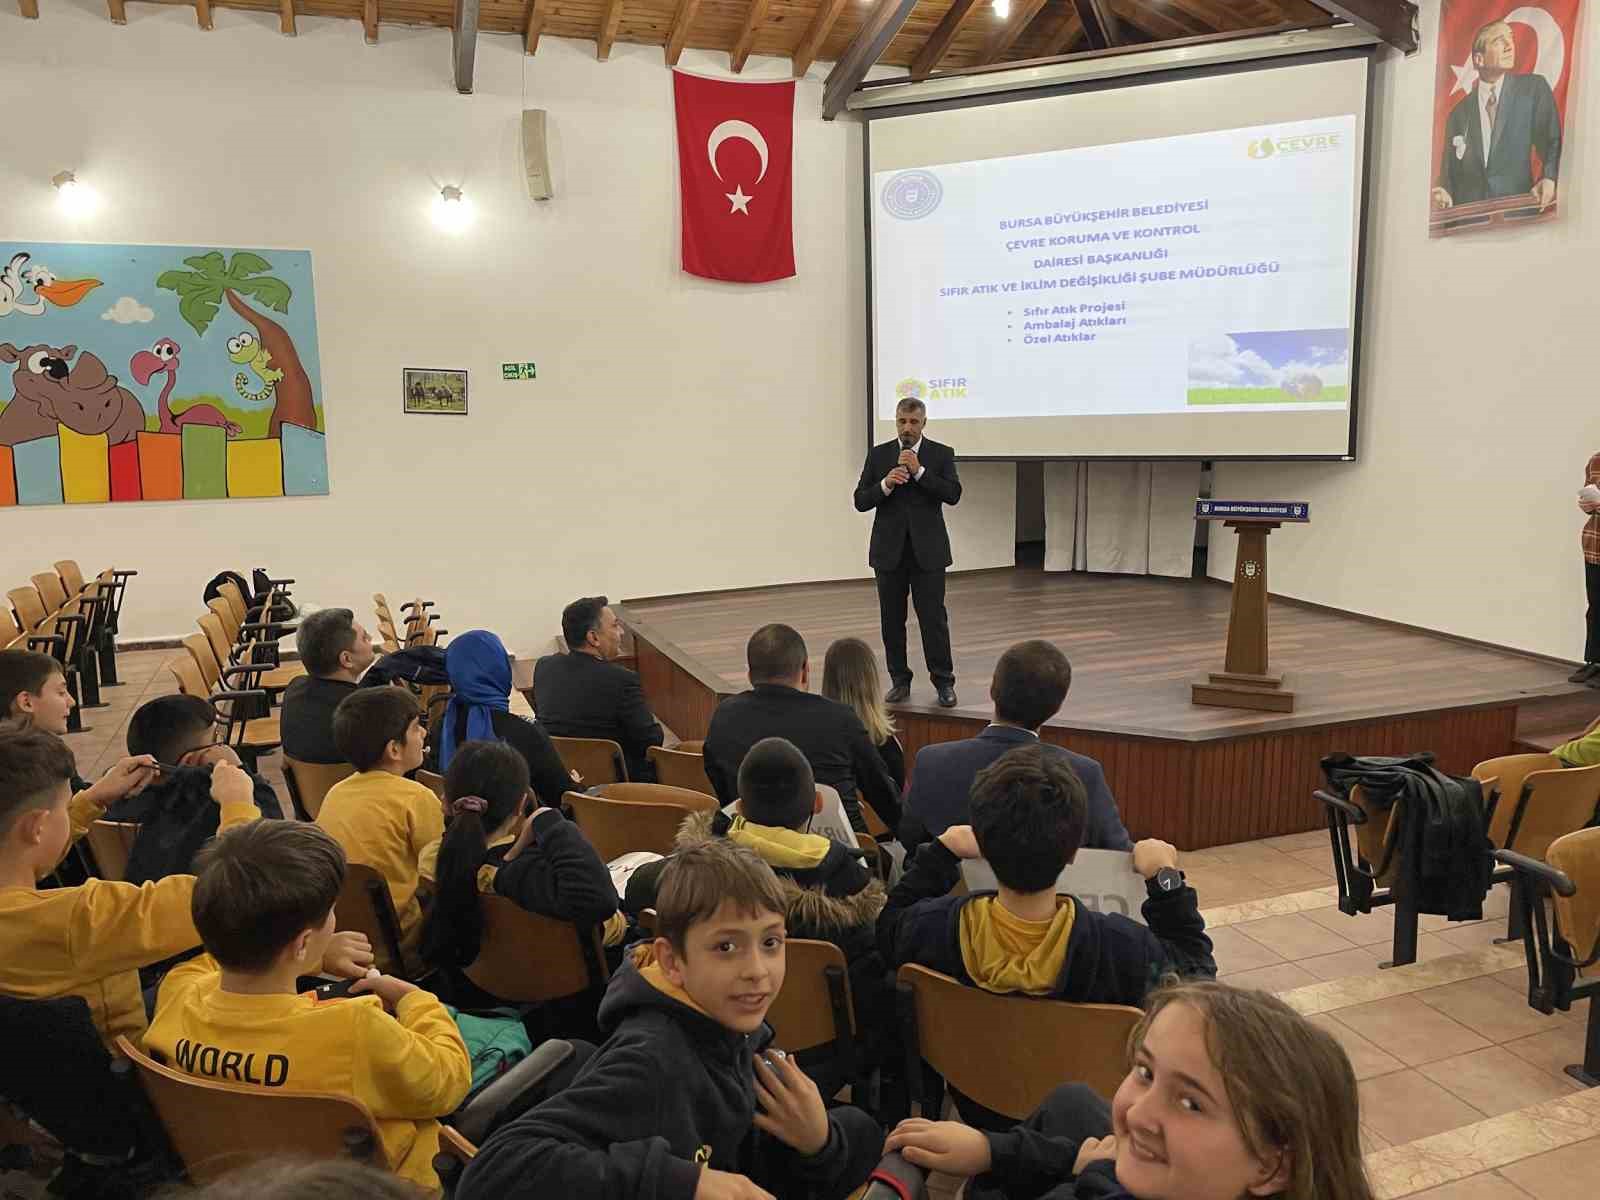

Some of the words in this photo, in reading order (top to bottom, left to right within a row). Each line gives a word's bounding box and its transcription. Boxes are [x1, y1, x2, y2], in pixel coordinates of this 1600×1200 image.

[999, 217, 1042, 230] BURSA
[1044, 207, 1129, 225] BÜYÜKŞEHİR
[1132, 199, 1209, 217] BELEDİYESİ
[1006, 237, 1046, 252] ÇEVRE
[1049, 231, 1110, 246] KORUMA
[1112, 229, 1130, 241] VE
[1133, 223, 1201, 239] KONTROL
[1034, 254, 1083, 269] DAİRESİ
[1087, 248, 1168, 265] BAŞKANLIĞI
[939, 286, 970, 297] SIFIR
[971, 283, 998, 295] ATIK
[1001, 281, 1018, 292] VE
[1020, 278, 1056, 291] İKLİM
[1060, 270, 1137, 288] DEĞİŞİKLİĞİ
[1140, 270, 1177, 284] ŞUBE
[1179, 260, 1281, 280] MÜDÜRLÜĞÜ
[1023, 305, 1049, 317] Sıfır
[1051, 303, 1077, 315] Atık
[1079, 301, 1126, 314] Projesi
[1023, 318, 1076, 331] Ambalaj
[1079, 315, 1127, 328] Atıkları
[1023, 332, 1052, 345] Özel
[1054, 332, 1097, 343] Atıklar
[928, 378, 967, 389] SIFIR
[930, 388, 967, 399] ATIK
[175, 1038, 289, 1087] WORLD
